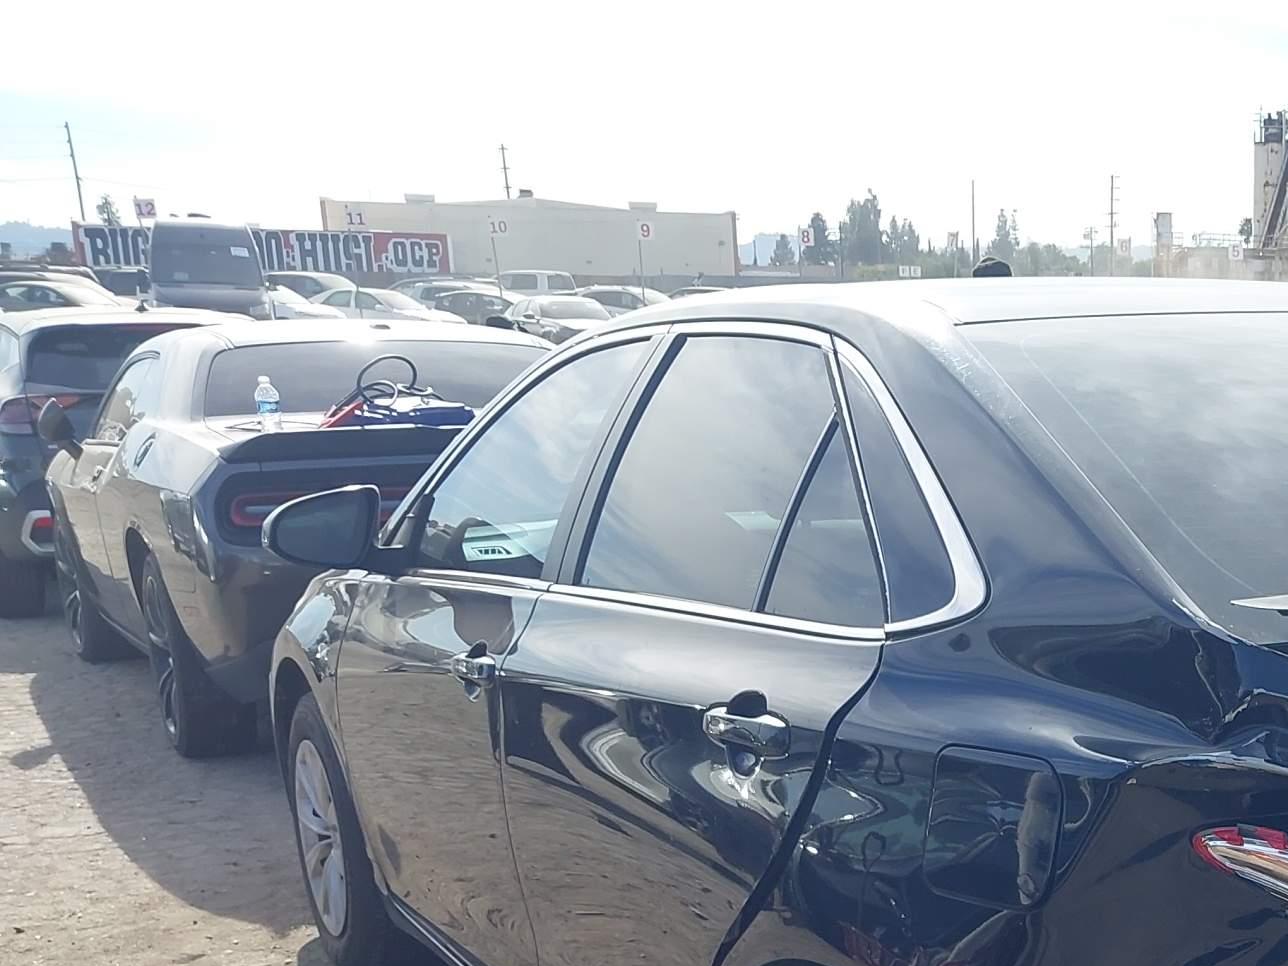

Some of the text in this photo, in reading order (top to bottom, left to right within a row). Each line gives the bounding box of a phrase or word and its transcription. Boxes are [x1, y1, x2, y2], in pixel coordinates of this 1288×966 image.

[136, 202, 156, 216] 12
[347, 212, 366, 225] 11
[490, 221, 507, 234] 10
[641, 223, 650, 238] 9
[801, 231, 810, 243] 8
[1232, 248, 1241, 259] 5
